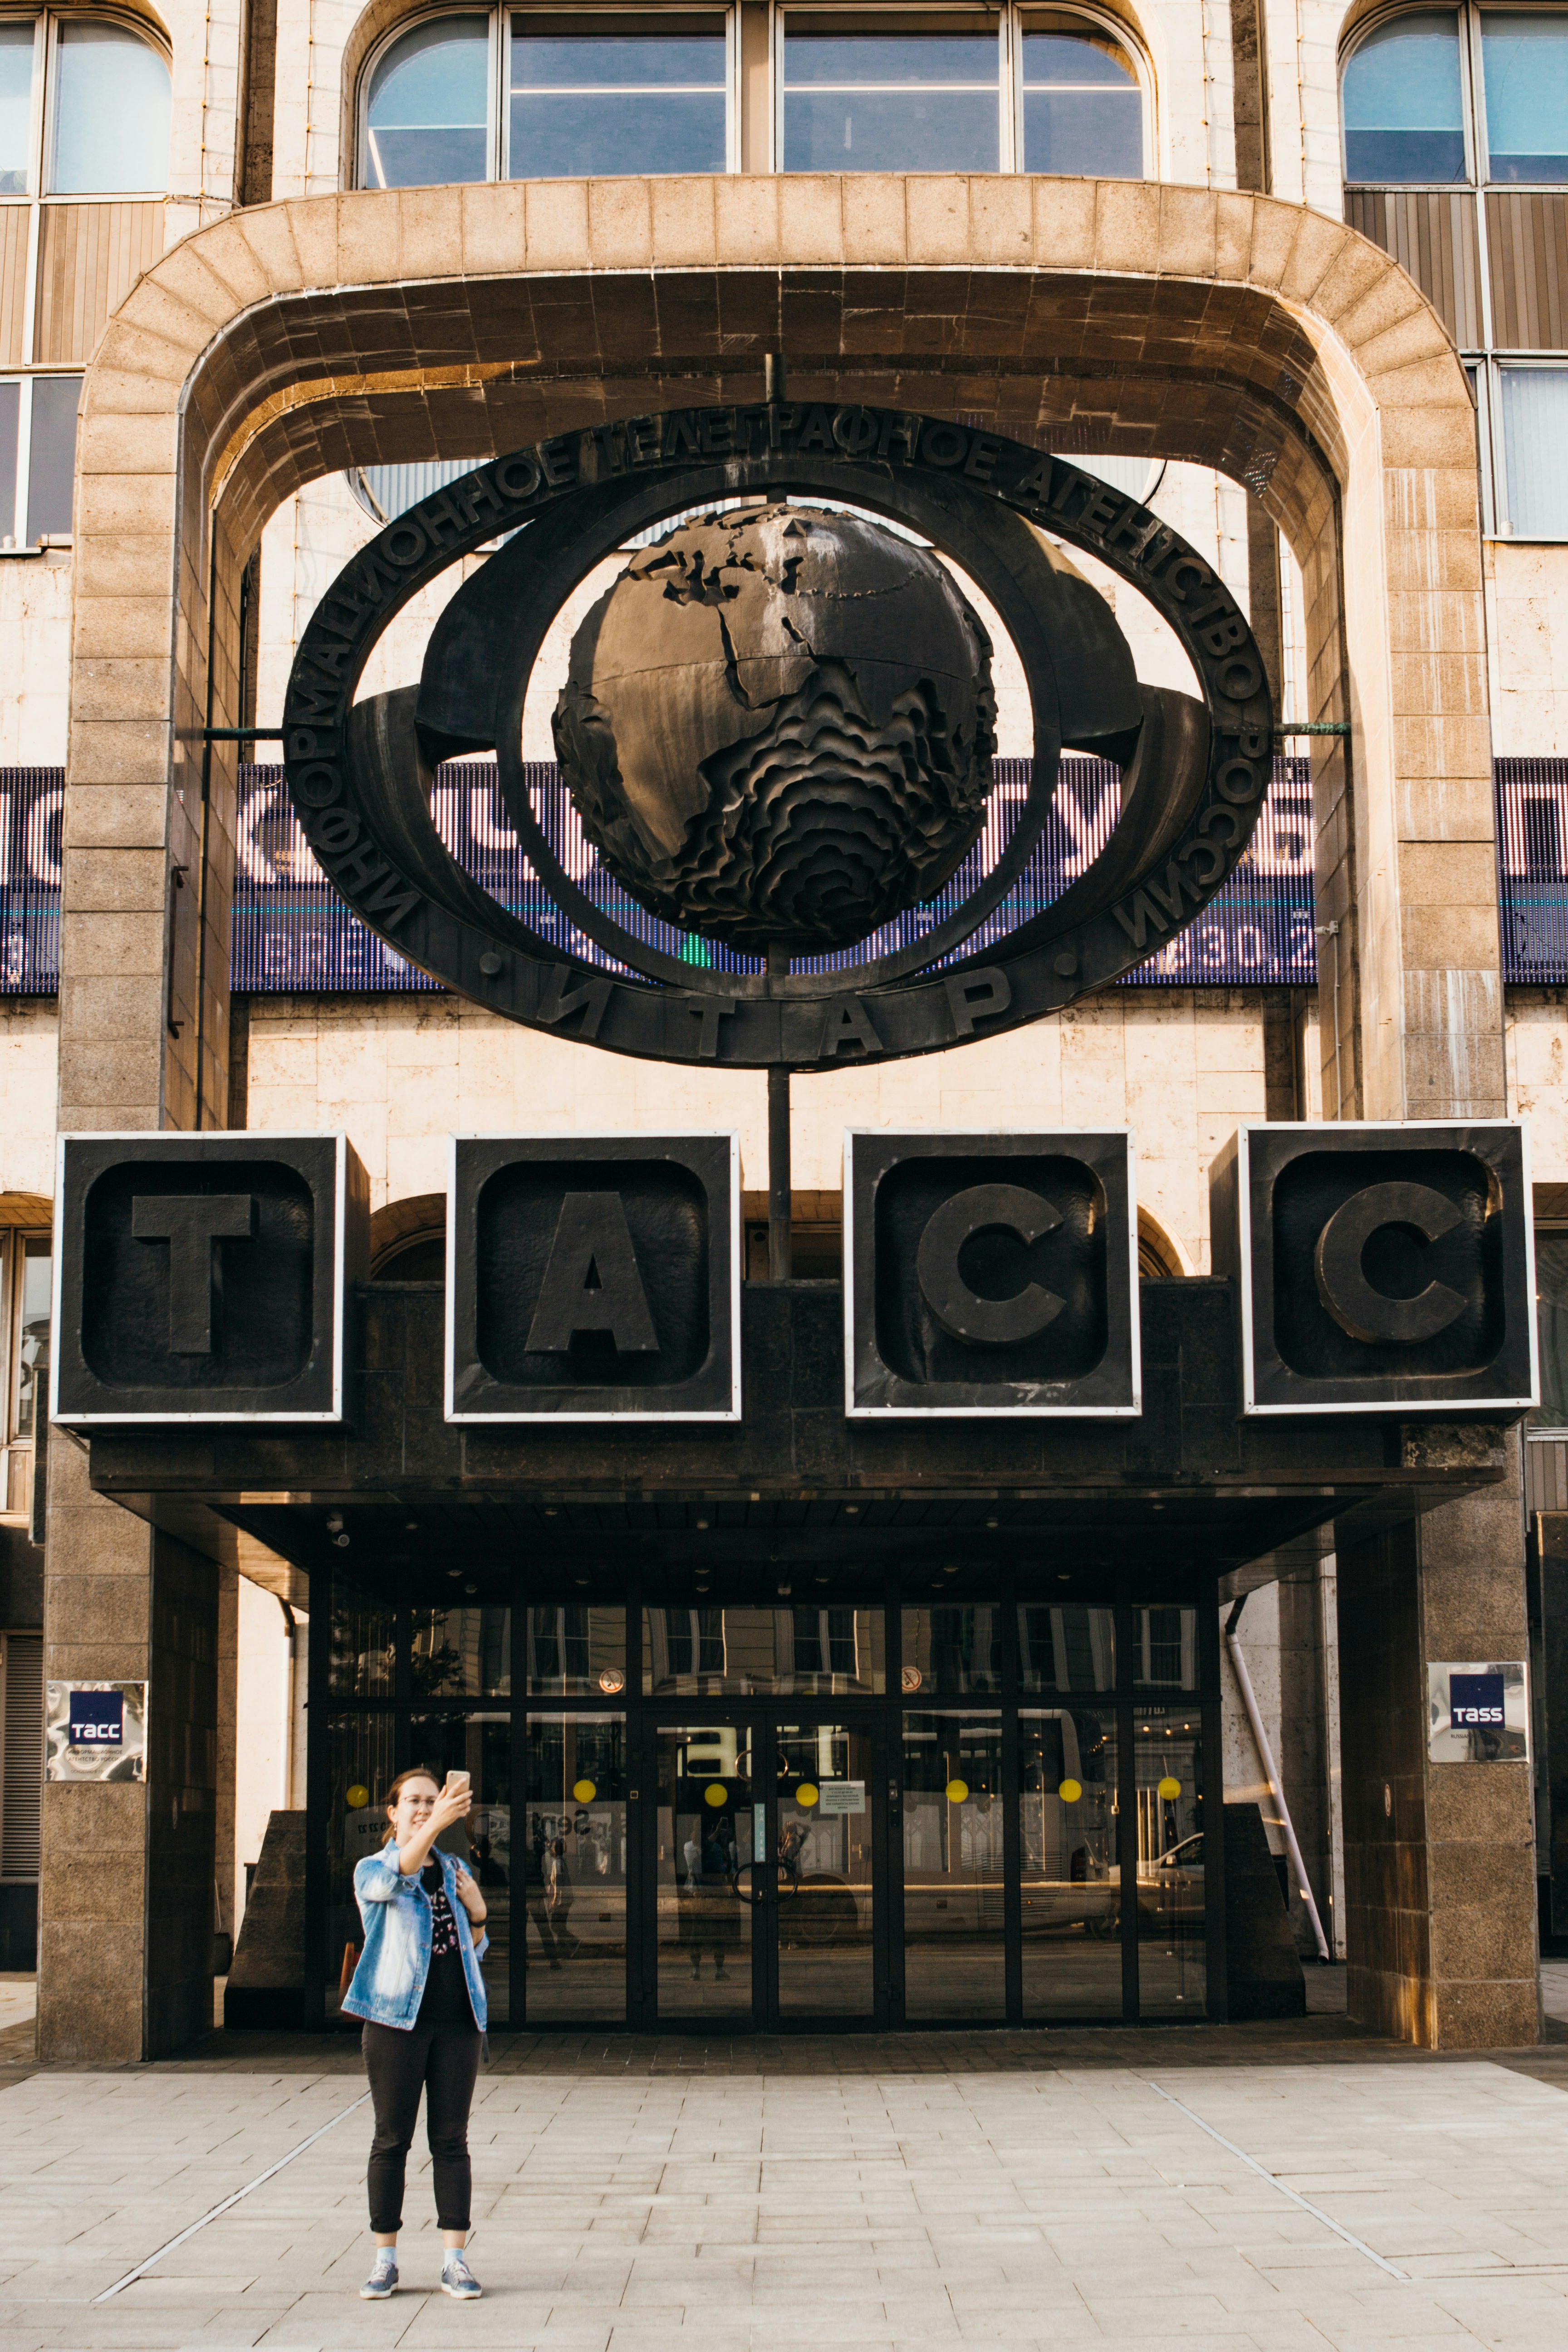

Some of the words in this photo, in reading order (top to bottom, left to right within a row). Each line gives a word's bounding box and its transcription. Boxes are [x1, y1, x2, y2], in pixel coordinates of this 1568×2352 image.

[592, 404, 1004, 480] ТЕЛЕГРАФНОЕ
[1014, 458, 1263, 701] АГЕНТСТВО
[288, 437, 577, 933] ИНФОРМАЦИОННОЕ
[1112, 726, 1269, 948] РОССИИ
[537, 965, 1011, 1058] ИТАР
[131, 1181, 1468, 1354] ТАСС
